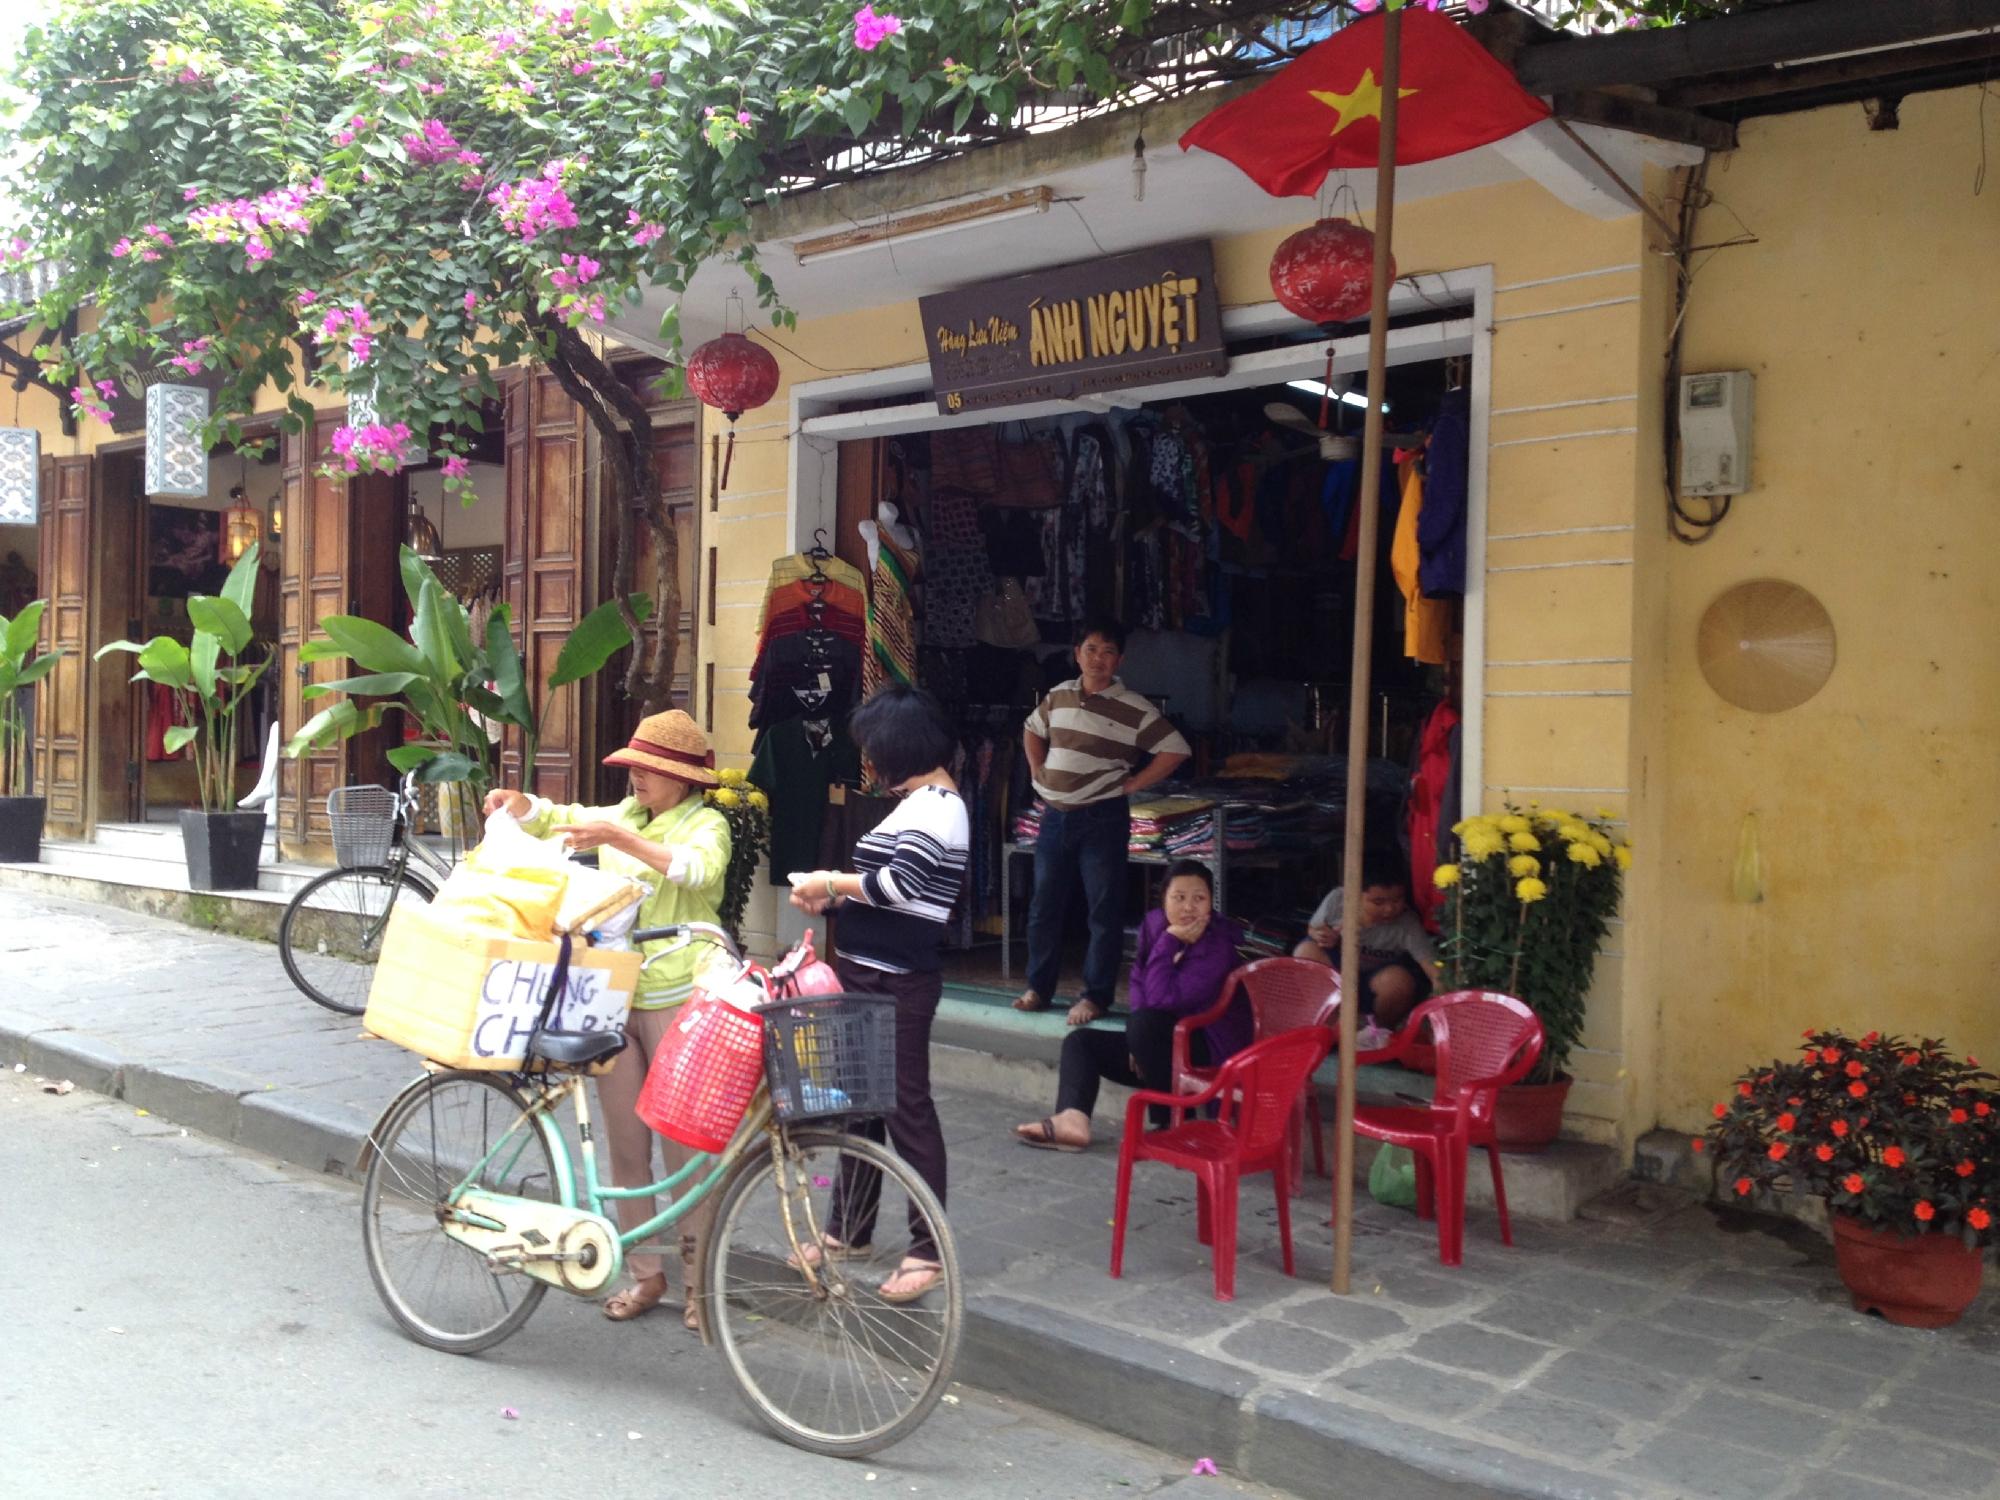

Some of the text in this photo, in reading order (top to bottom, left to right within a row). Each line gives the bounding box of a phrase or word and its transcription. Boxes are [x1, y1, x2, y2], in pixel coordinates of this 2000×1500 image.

[1029, 297, 1083, 367] ÁNH
[1087, 271, 1198, 354] NGUYỆT
[947, 392, 962, 409] 05
